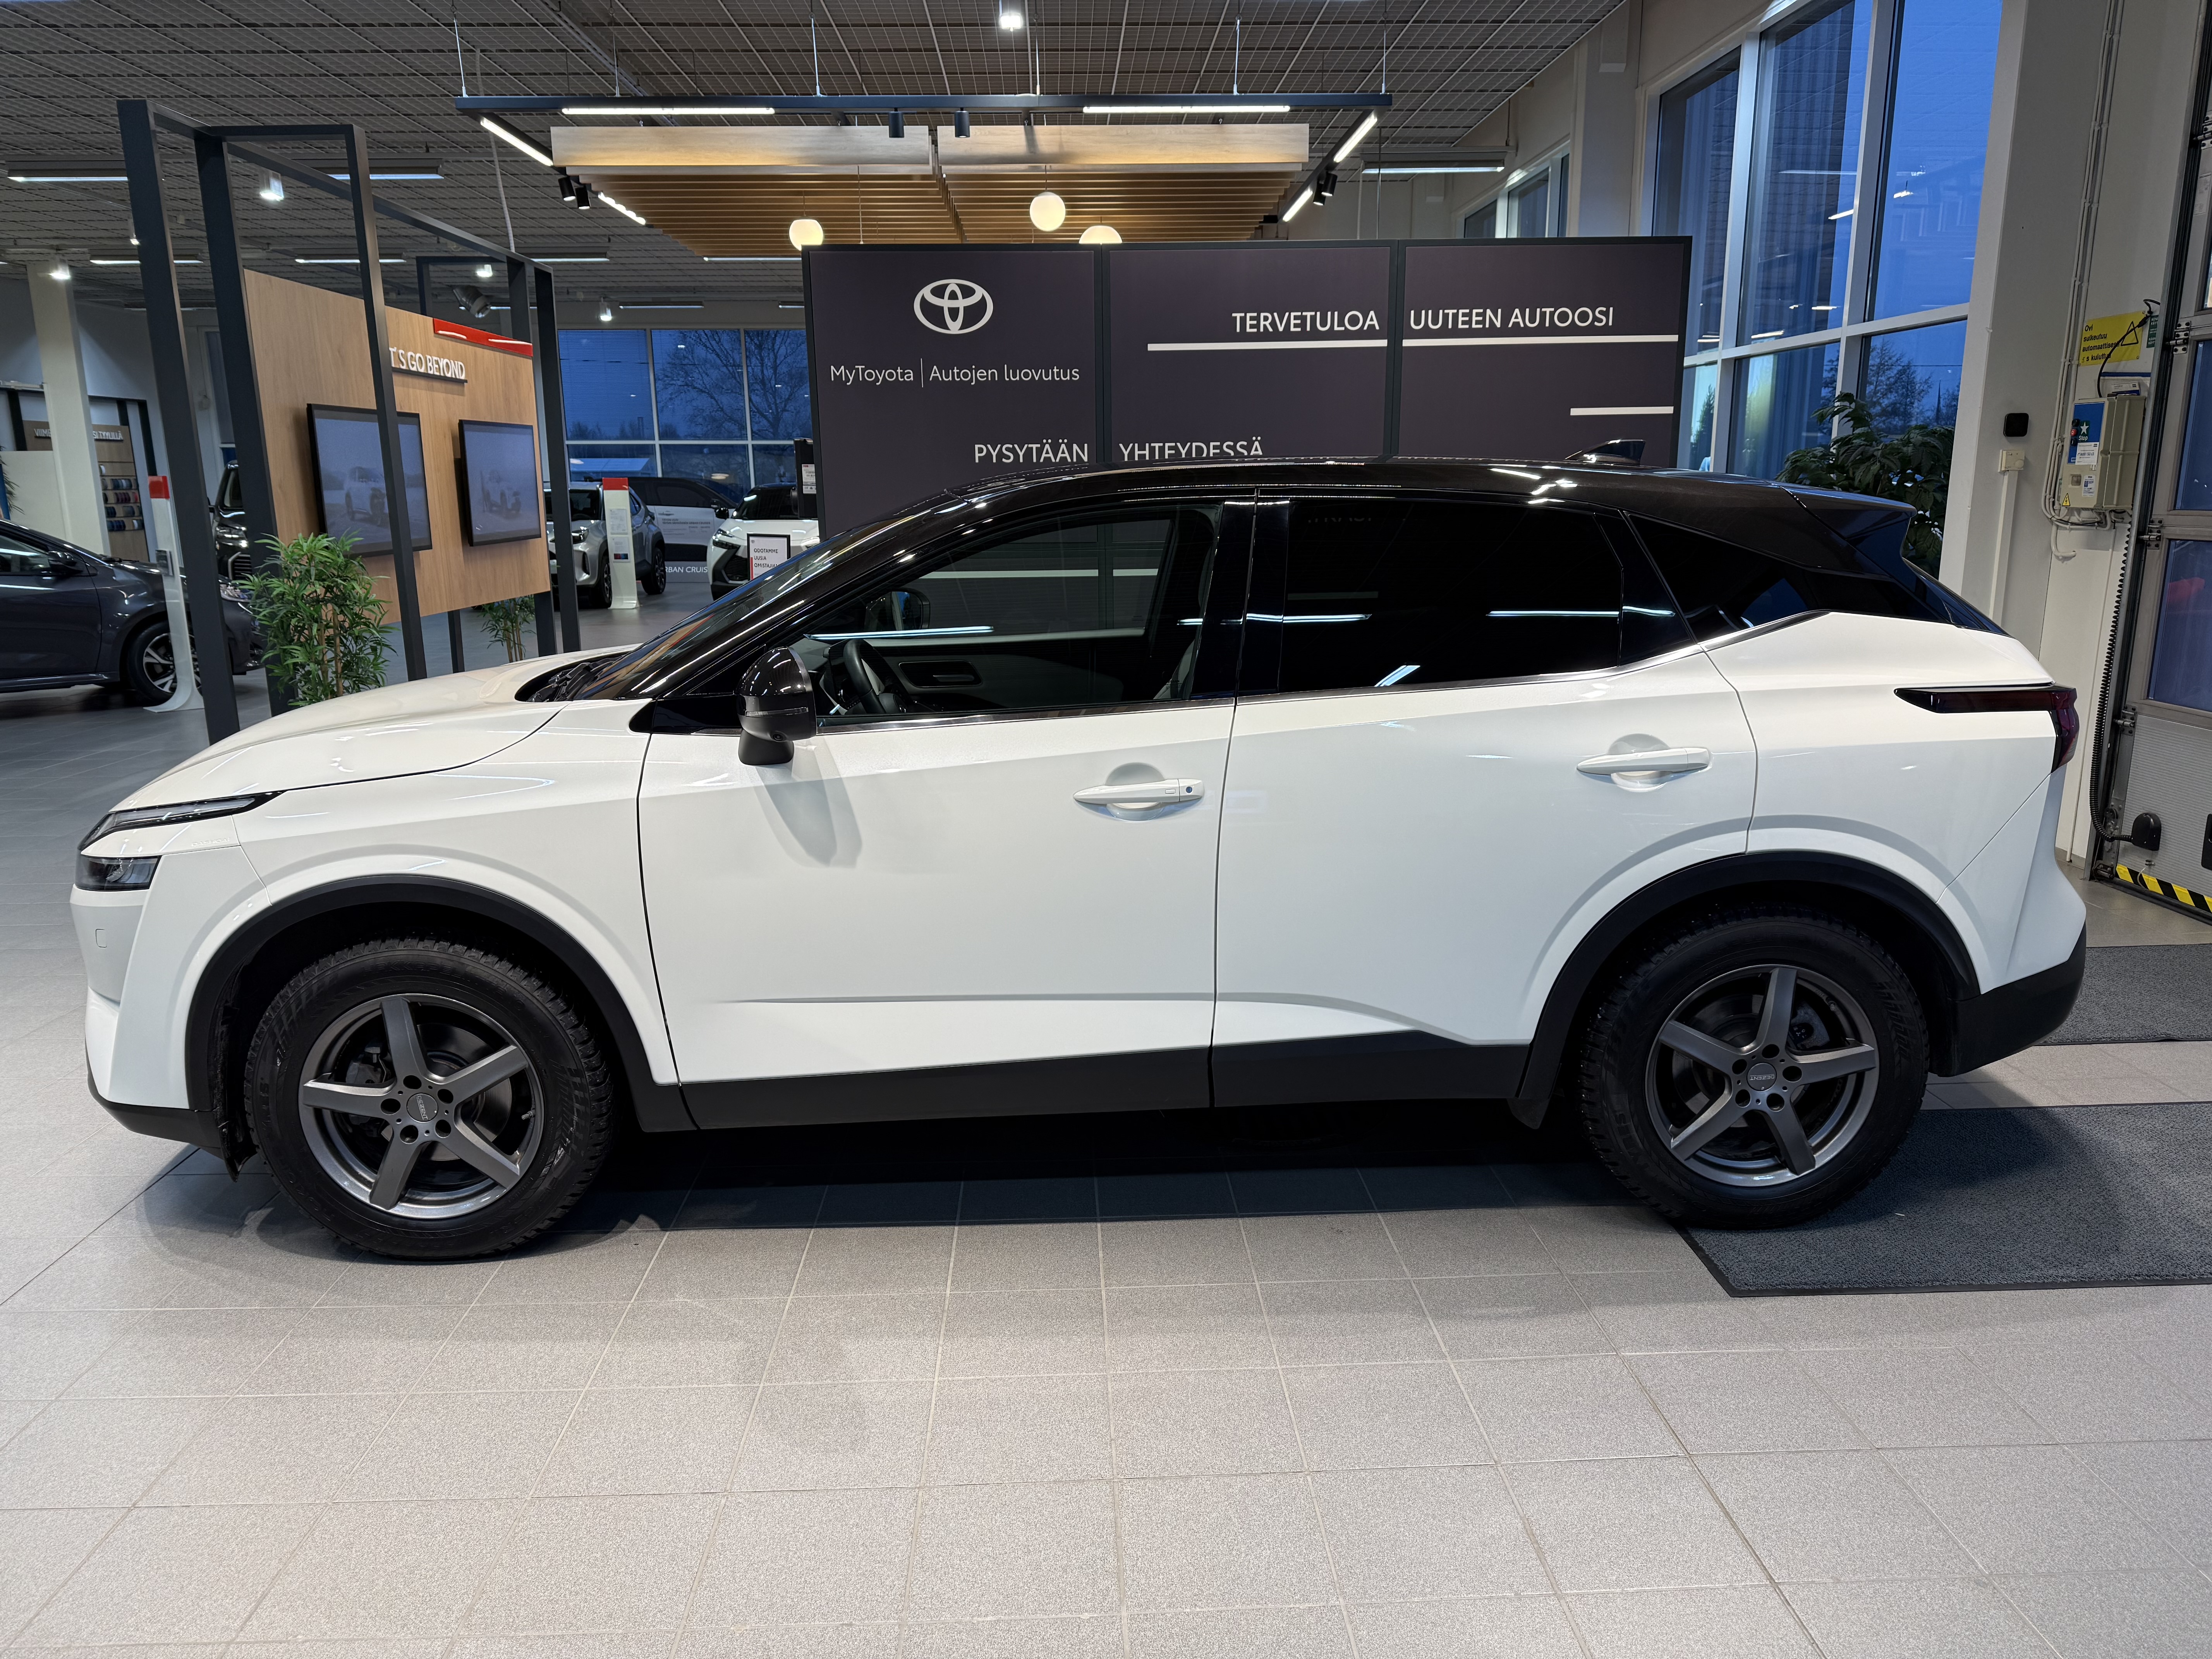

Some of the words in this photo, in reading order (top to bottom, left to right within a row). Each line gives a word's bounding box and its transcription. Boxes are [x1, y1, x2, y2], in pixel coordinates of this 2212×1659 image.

[1231, 310, 1380, 332] TERVETULOA
[1410, 308, 1502, 330] UUTEEN
[1508, 307, 1613, 327] AUTOOSI
[2085, 324, 2093, 332] Ovi
[2083, 333, 2107, 342] sulkeutuu
[407, 351, 425, 373] GO
[426, 354, 465, 380] BEYOND
[830, 365, 914, 385] MyToyota
[929, 365, 998, 385] Autojen
[1004, 364, 1080, 381] luovutus
[99, 430, 124, 440] TYYLILLÄ
[974, 439, 1088, 463] PYSYTÄÄN
[1119, 436, 1263, 461] YHTEYDESSÄ
[417, 1096, 428, 1120] DEZENT
